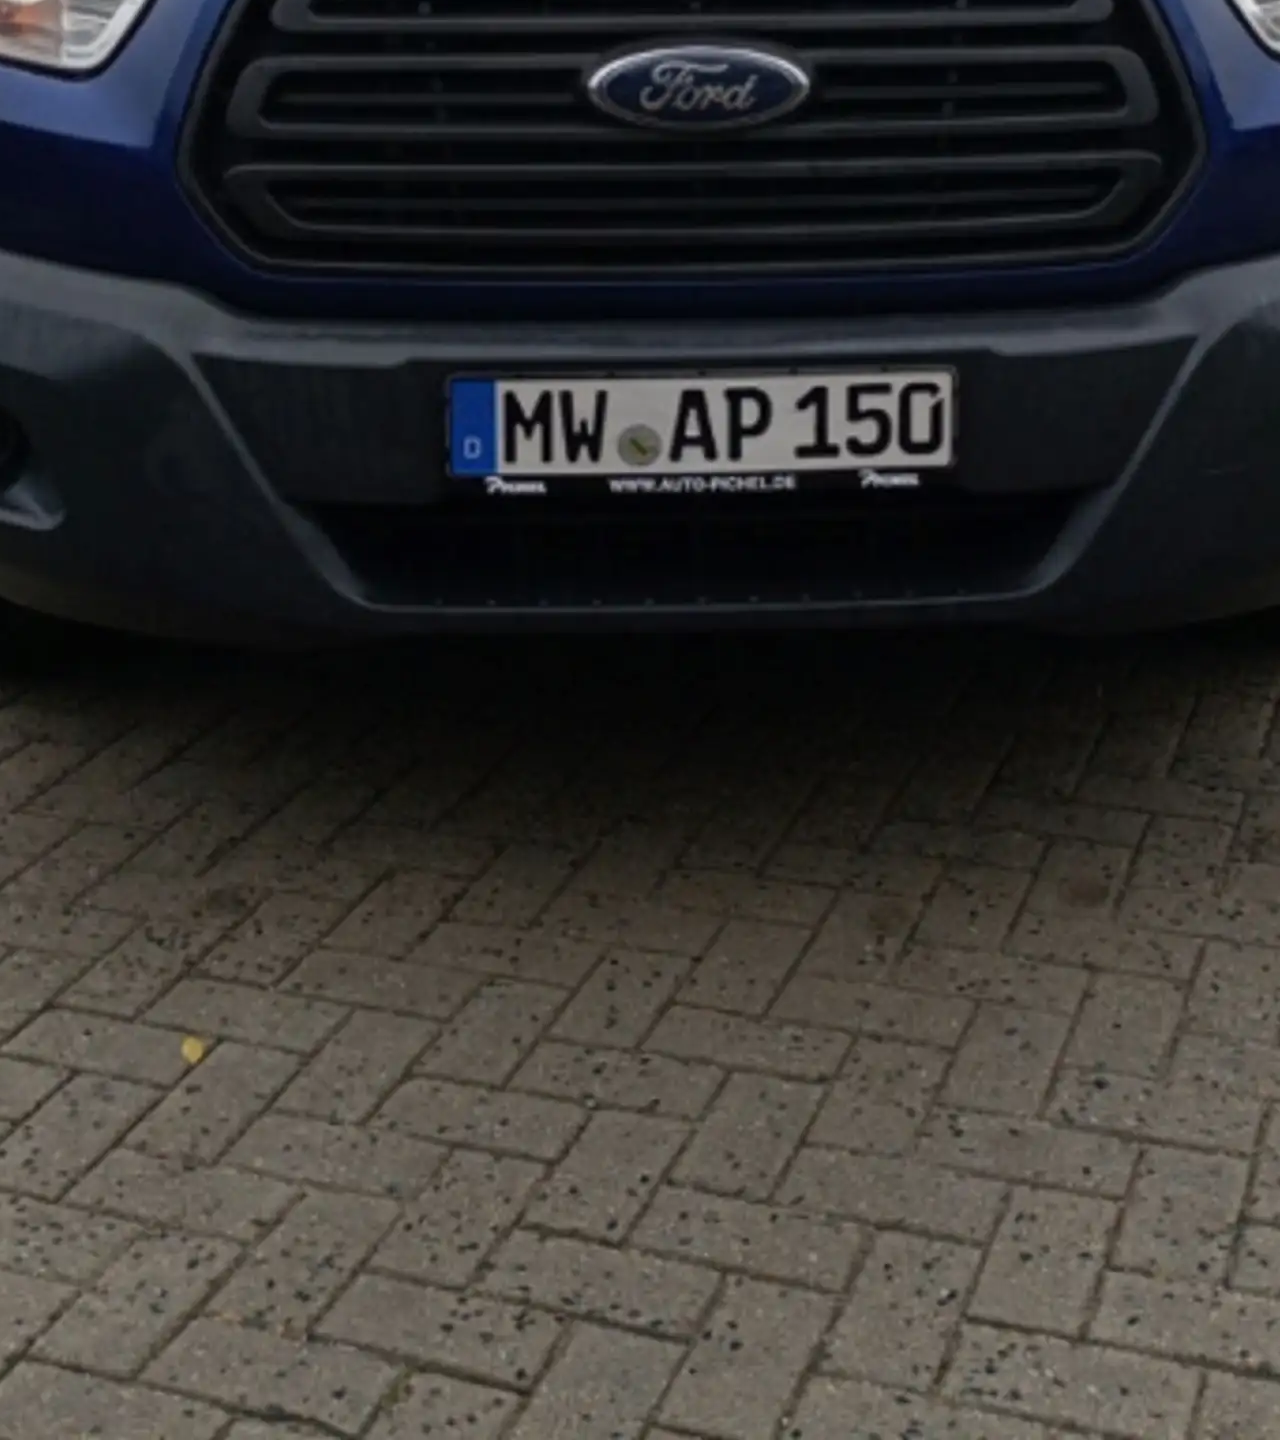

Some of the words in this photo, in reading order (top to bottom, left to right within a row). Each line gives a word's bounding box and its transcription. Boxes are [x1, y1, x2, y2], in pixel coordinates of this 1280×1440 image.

[639, 59, 760, 112] Ford
[463, 436, 481, 460] D
[502, 389, 608, 464] MW
[669, 386, 773, 462] AP
[794, 382, 945, 459] 150
